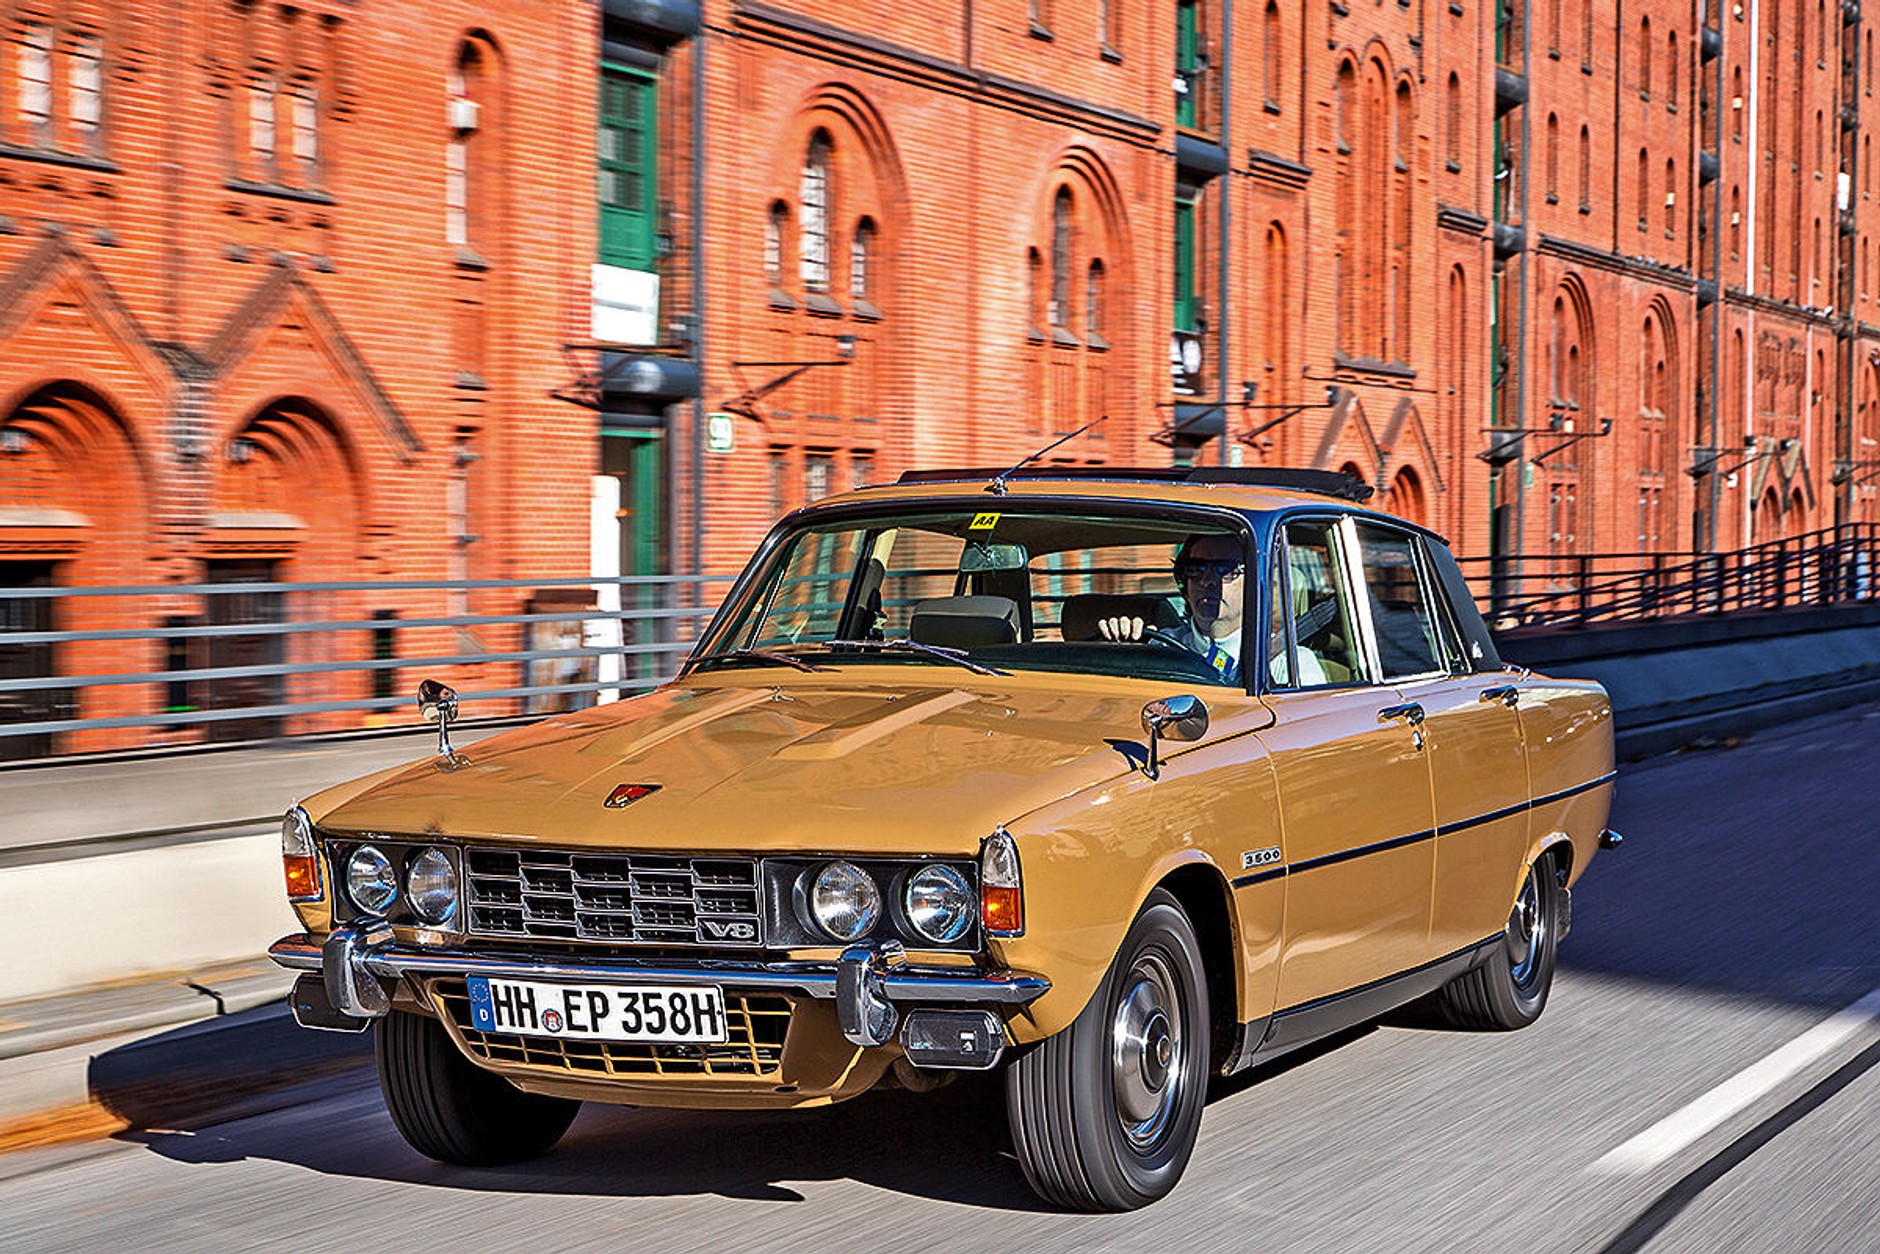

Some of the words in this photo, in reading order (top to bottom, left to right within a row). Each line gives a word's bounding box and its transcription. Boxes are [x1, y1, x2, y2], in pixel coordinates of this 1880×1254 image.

[973, 515, 996, 527] AA
[1245, 849, 1281, 865] 3500
[703, 921, 755, 939] V8
[479, 1008, 489, 1022] D
[491, 984, 539, 1029] HH
[562, 989, 611, 1033] EP
[617, 992, 719, 1036] 358H
